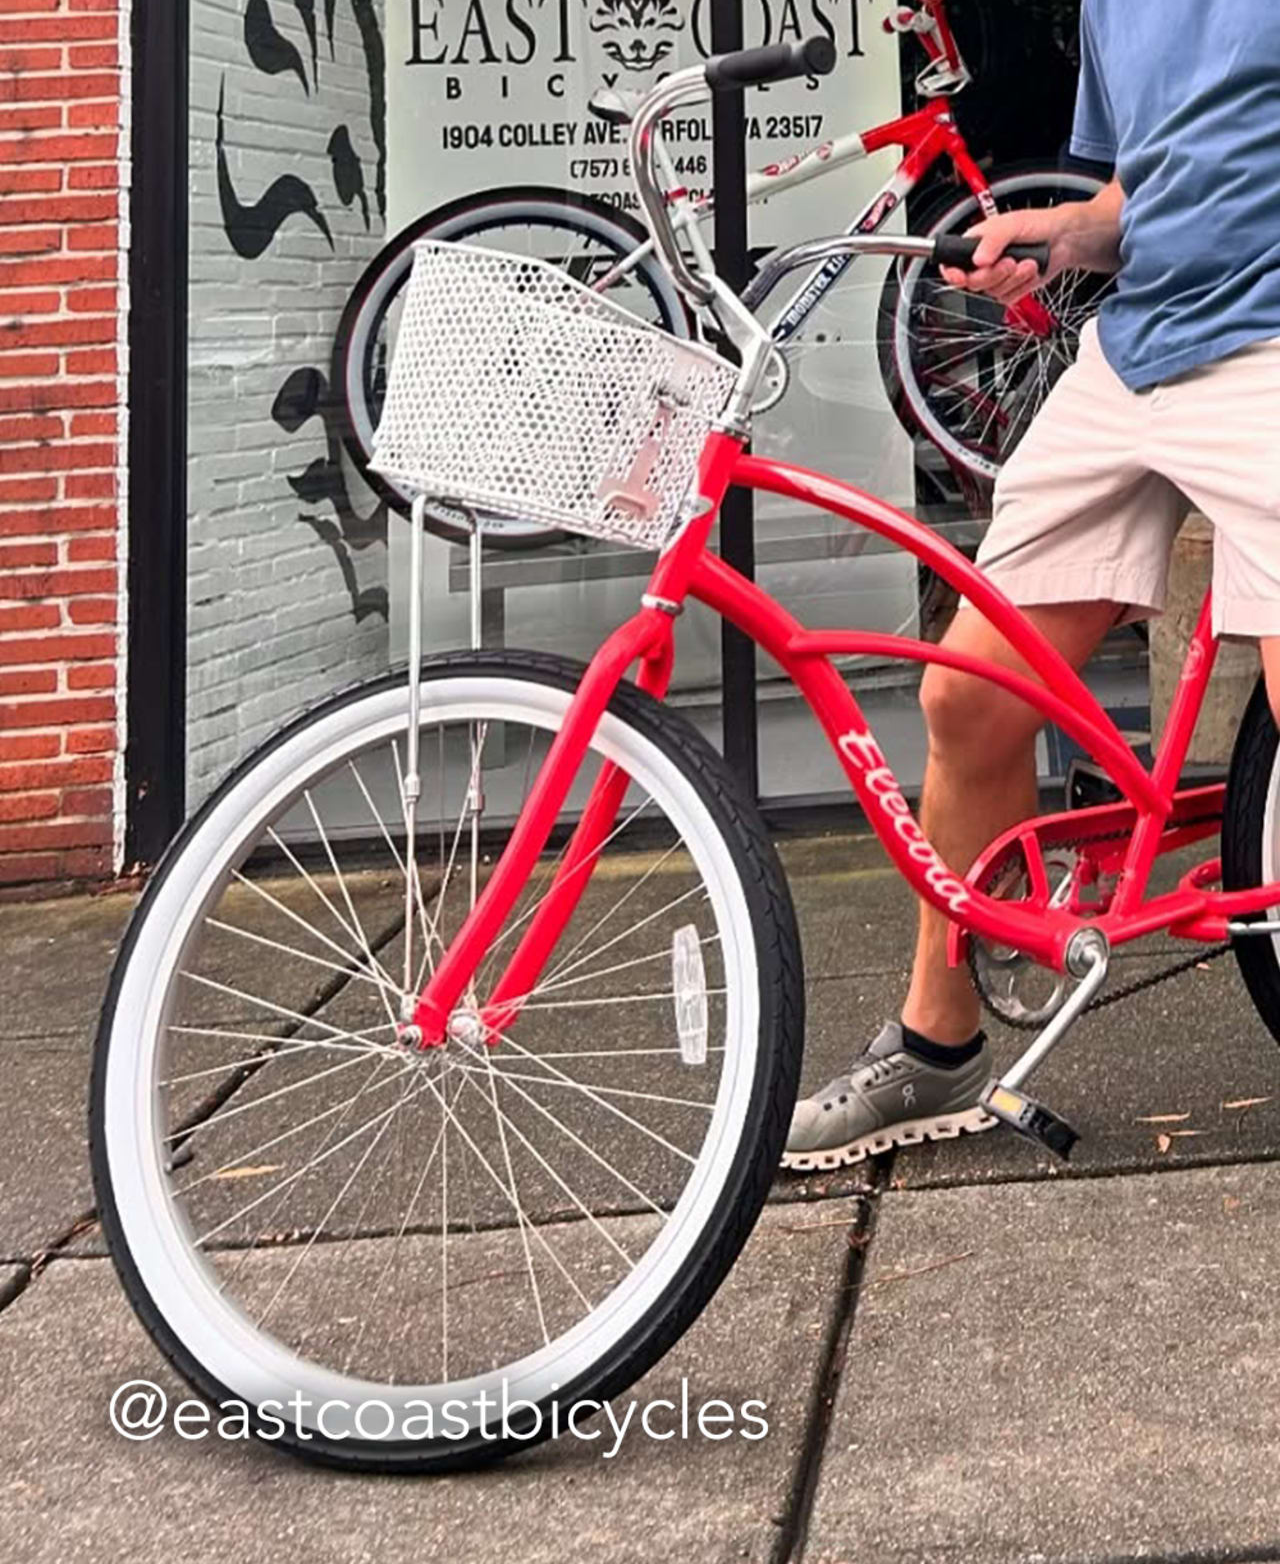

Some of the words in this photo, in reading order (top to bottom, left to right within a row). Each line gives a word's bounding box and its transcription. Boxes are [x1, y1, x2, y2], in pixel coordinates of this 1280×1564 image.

[442, 125, 493, 149] 1904
[499, 122, 577, 147] COLLEY
[583, 123, 628, 145] AVE.
[765, 116, 824, 138] 23517
[569, 158, 619, 178] (757)
[838, 729, 972, 914] Electra
